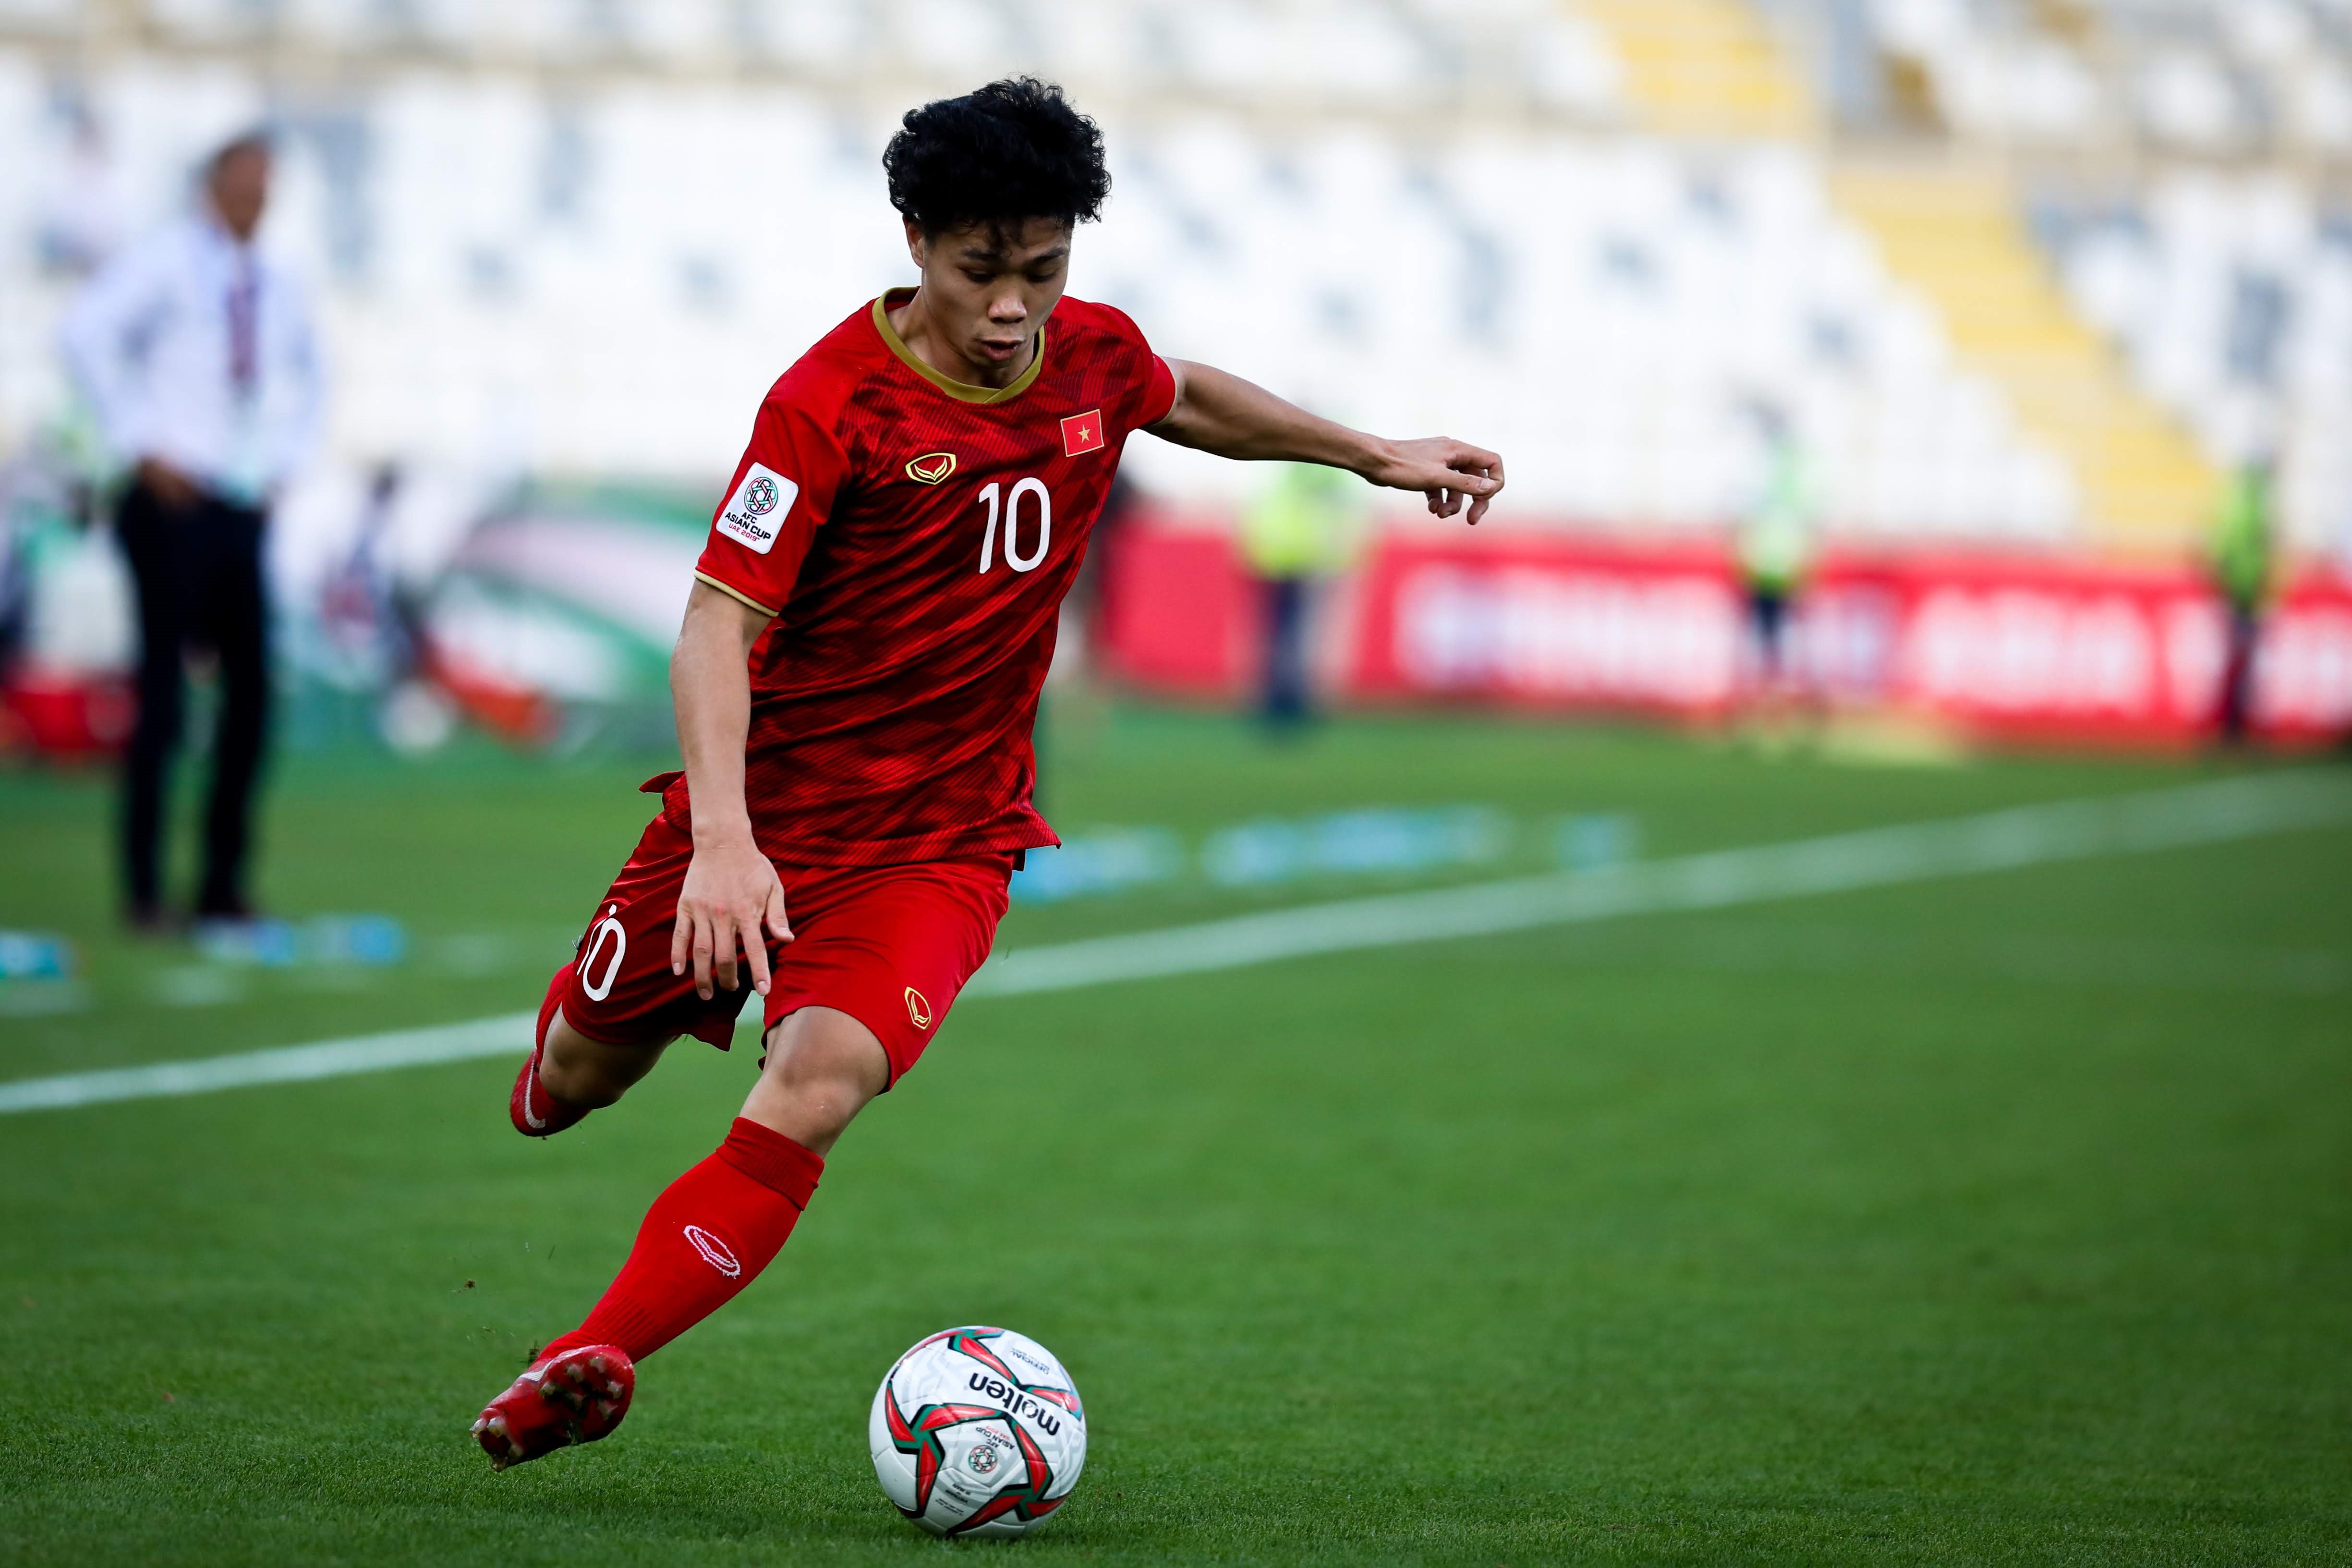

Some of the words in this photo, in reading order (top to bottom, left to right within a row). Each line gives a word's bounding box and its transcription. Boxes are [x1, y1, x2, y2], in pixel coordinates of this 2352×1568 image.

[741, 512, 757, 524] AFC
[725, 512, 749, 530] ASIAN
[750, 525, 771, 540] CUP
[728, 523, 740, 533] UAE
[979, 477, 1051, 574] 10
[1010, 1350, 1049, 1374] OFFICIAL
[969, 1372, 1061, 1436] molten
[976, 1427, 992, 1437] CUP
[986, 1438, 999, 1448] AFC
[992, 1435, 1015, 1449] ASIAN
